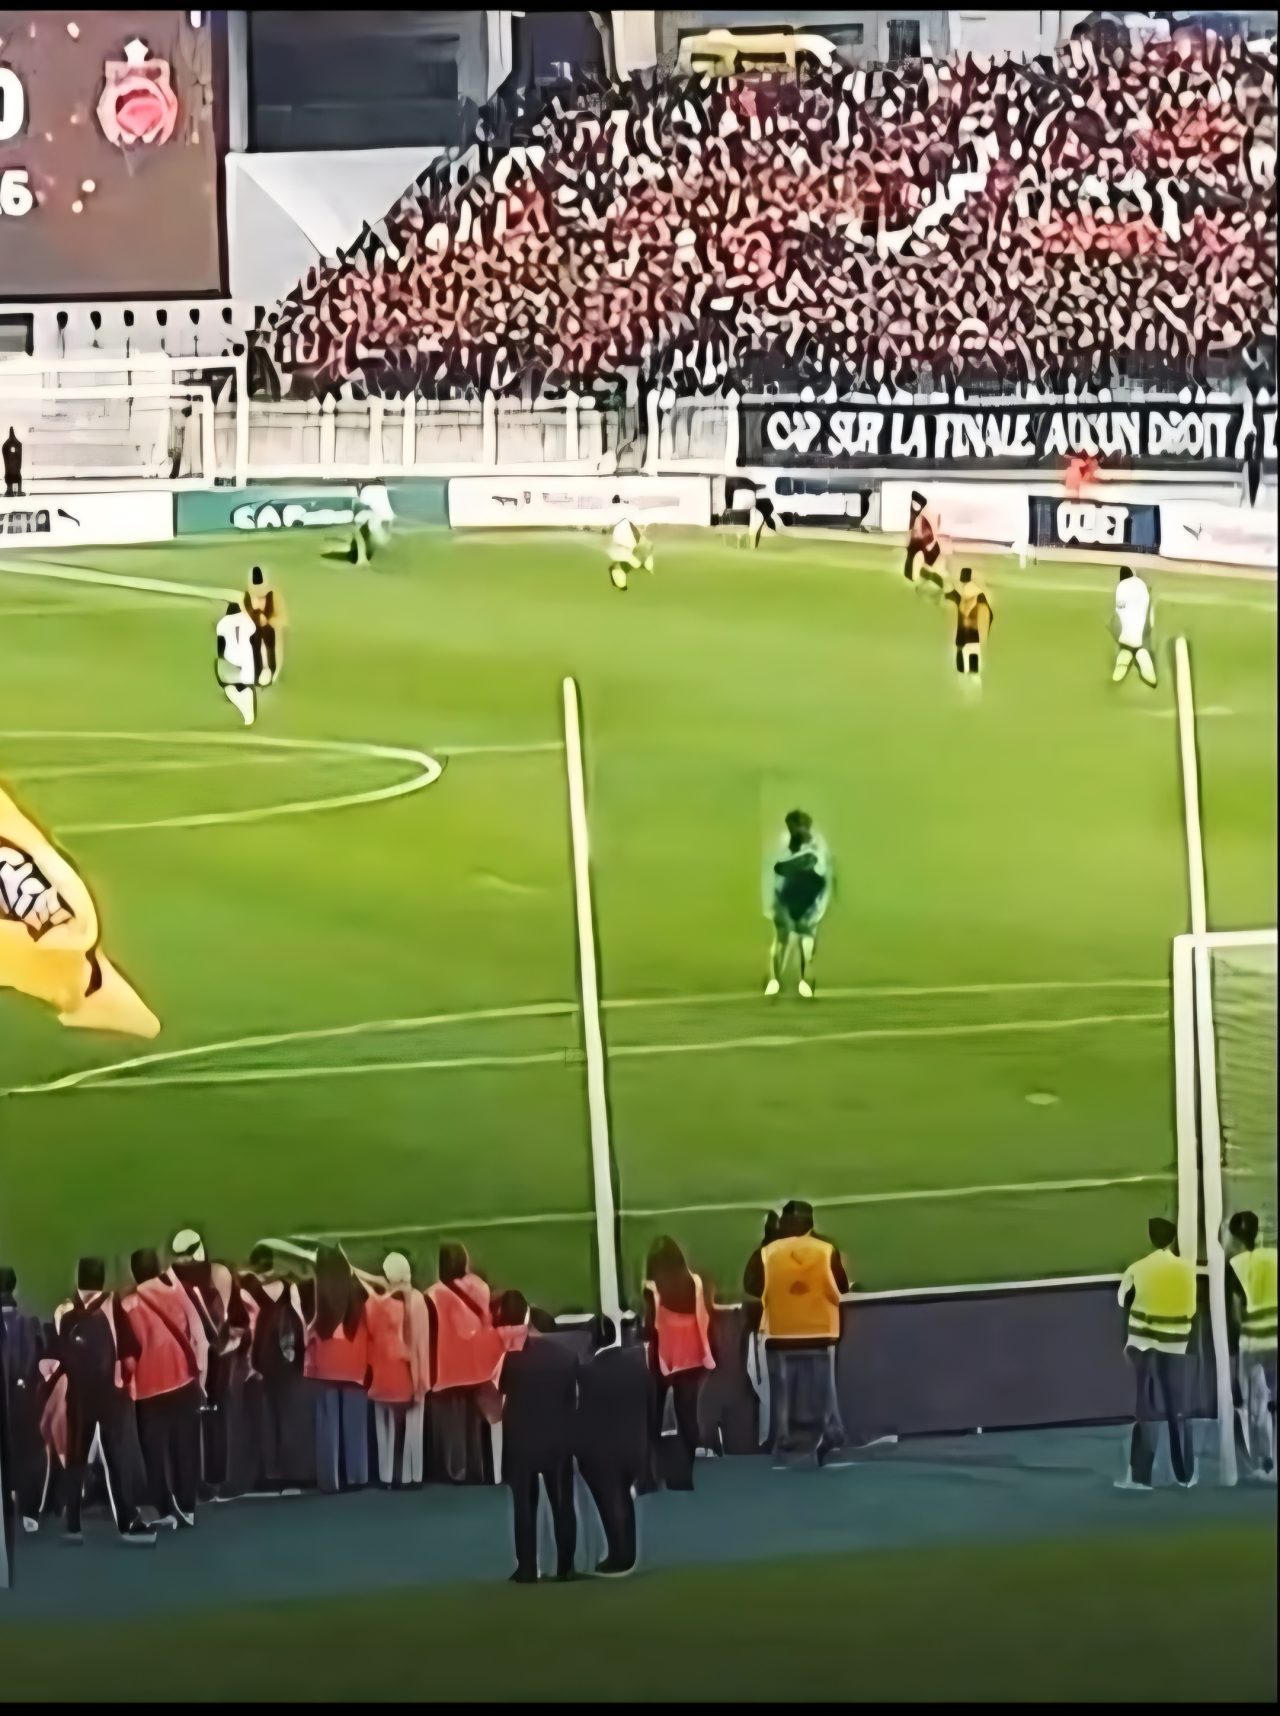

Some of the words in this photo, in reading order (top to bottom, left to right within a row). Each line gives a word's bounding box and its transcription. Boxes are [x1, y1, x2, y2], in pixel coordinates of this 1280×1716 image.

[828, 410, 885, 458] SUR
[891, 412, 927, 458] LA
[934, 412, 1036, 458] FINALE
